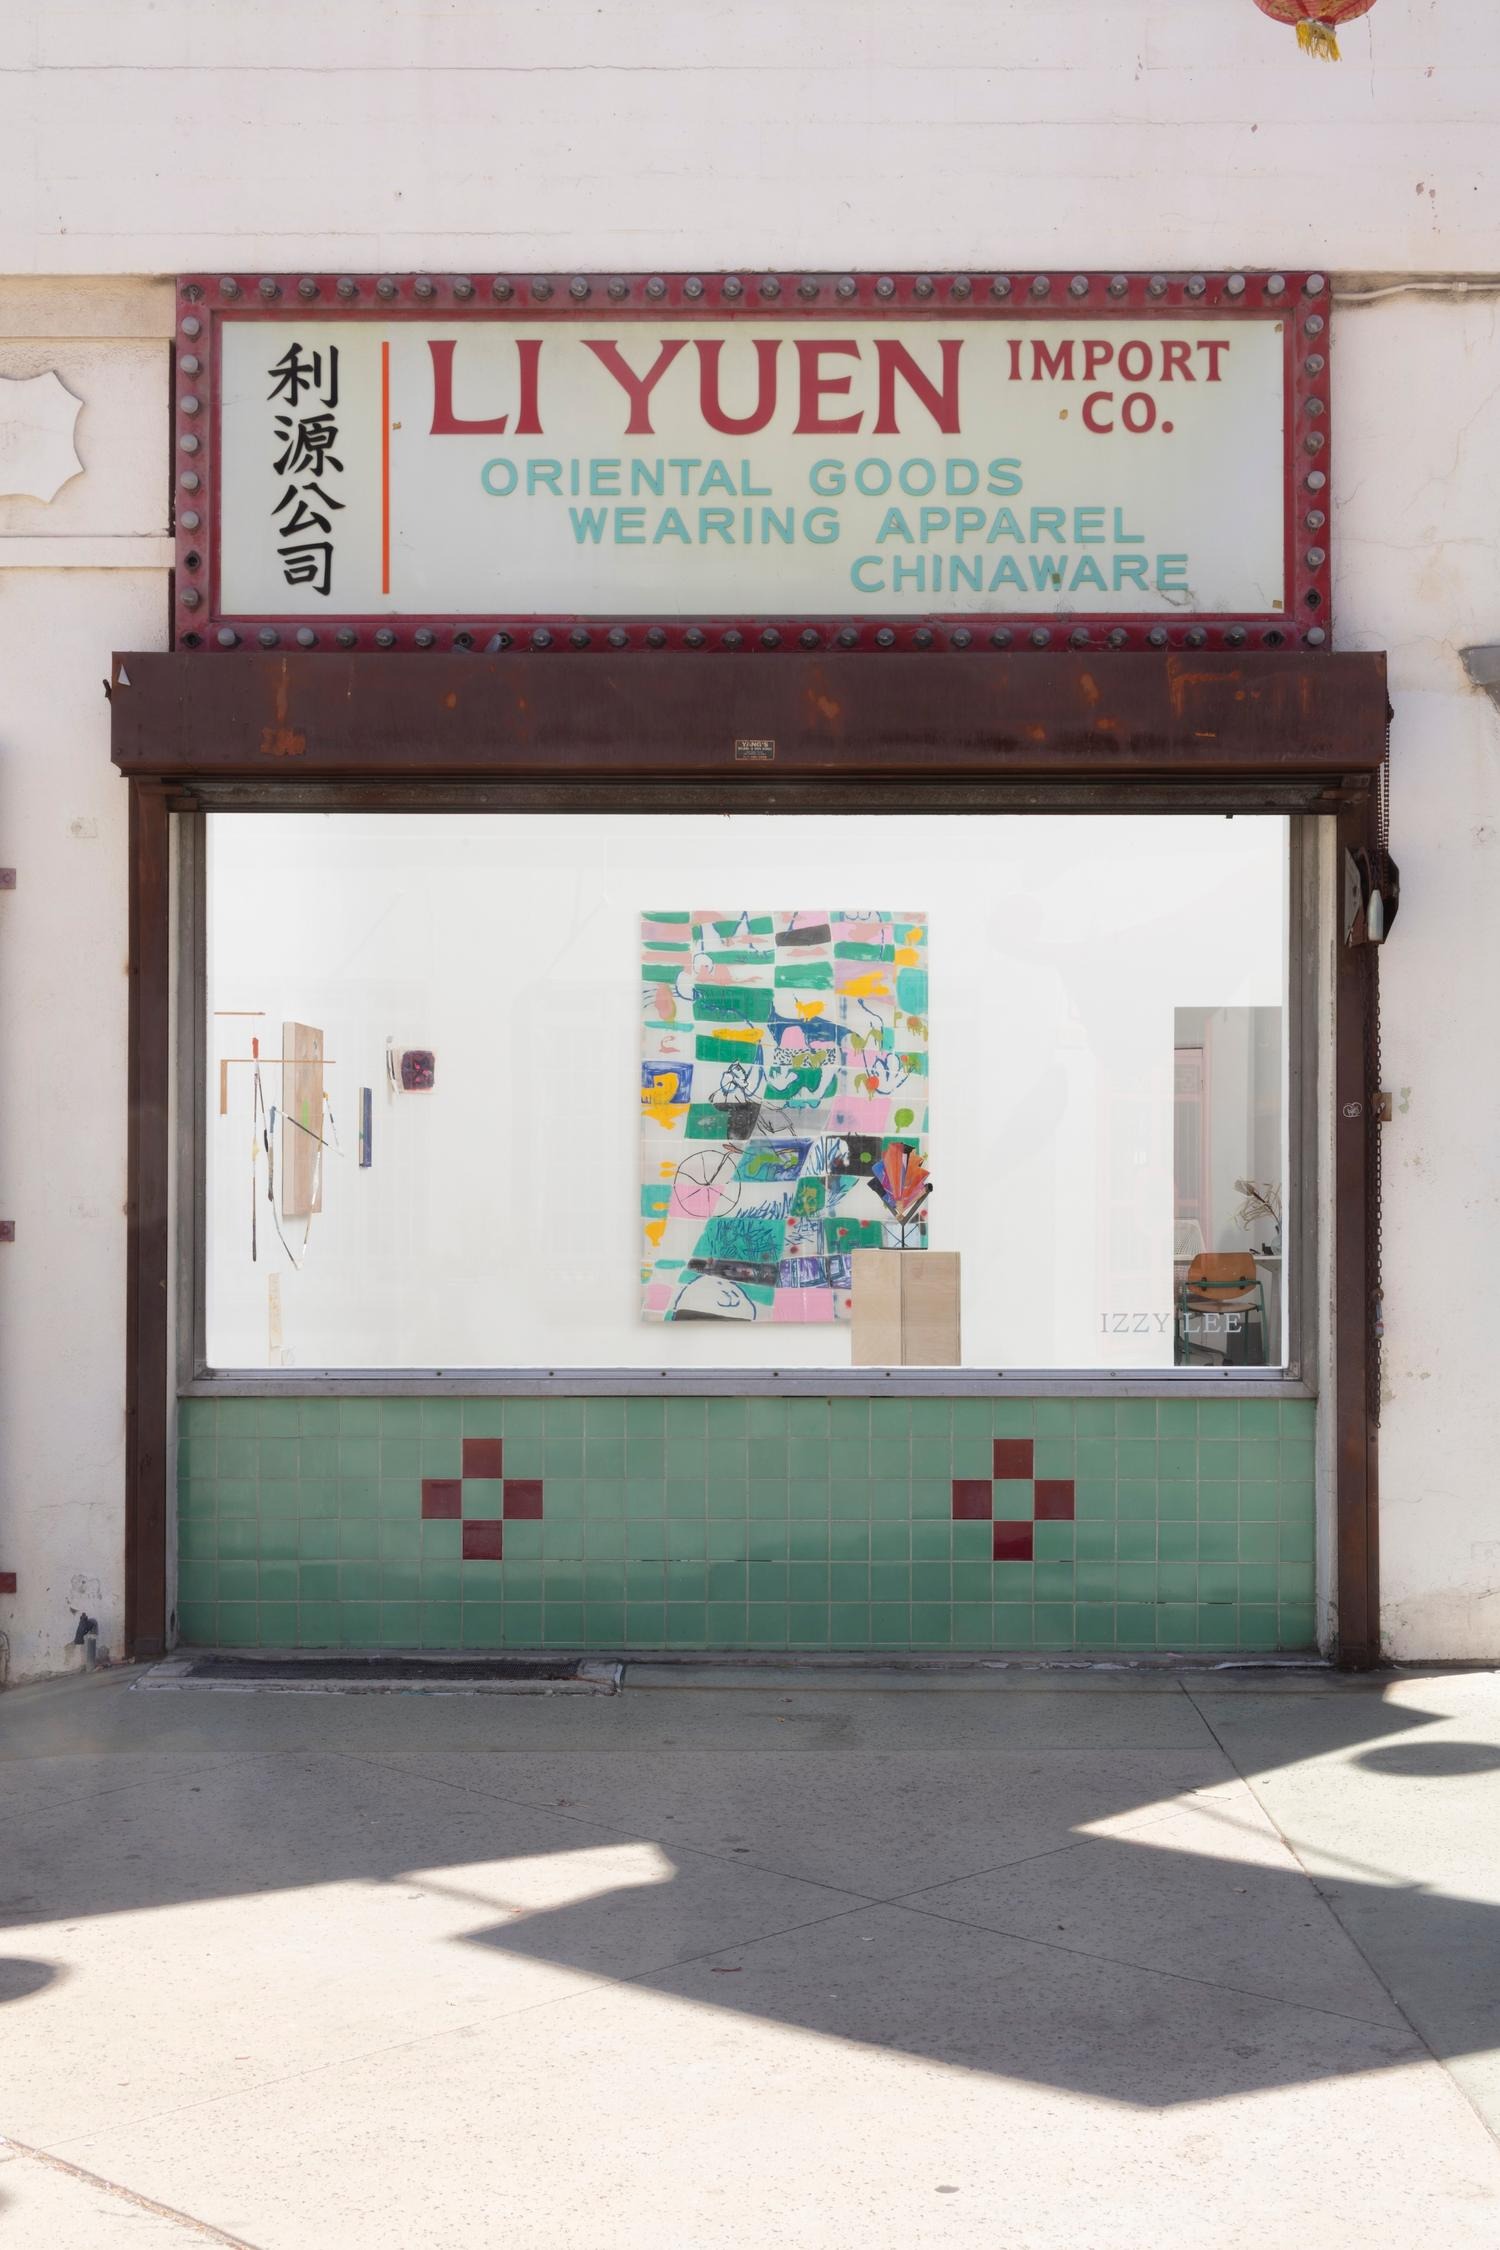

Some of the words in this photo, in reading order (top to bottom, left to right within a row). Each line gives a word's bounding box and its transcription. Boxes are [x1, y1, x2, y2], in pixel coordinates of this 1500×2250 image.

[1006, 339, 1231, 382] IMPORT
[427, 339, 543, 435] LI
[580, 339, 963, 436] YUEN
[1081, 391, 1175, 435] CO.
[266, 342, 347, 596] 利源公司
[480, 457, 773, 496] ORIENTAL
[808, 457, 1024, 496] GOODS
[568, 506, 841, 545] WEARING
[875, 506, 1146, 545] APPAREL
[849, 553, 1190, 593] CHINAWARE
[1100, 1312, 1171, 1334] IZZY
[1183, 1312, 1243, 1334] LEE
